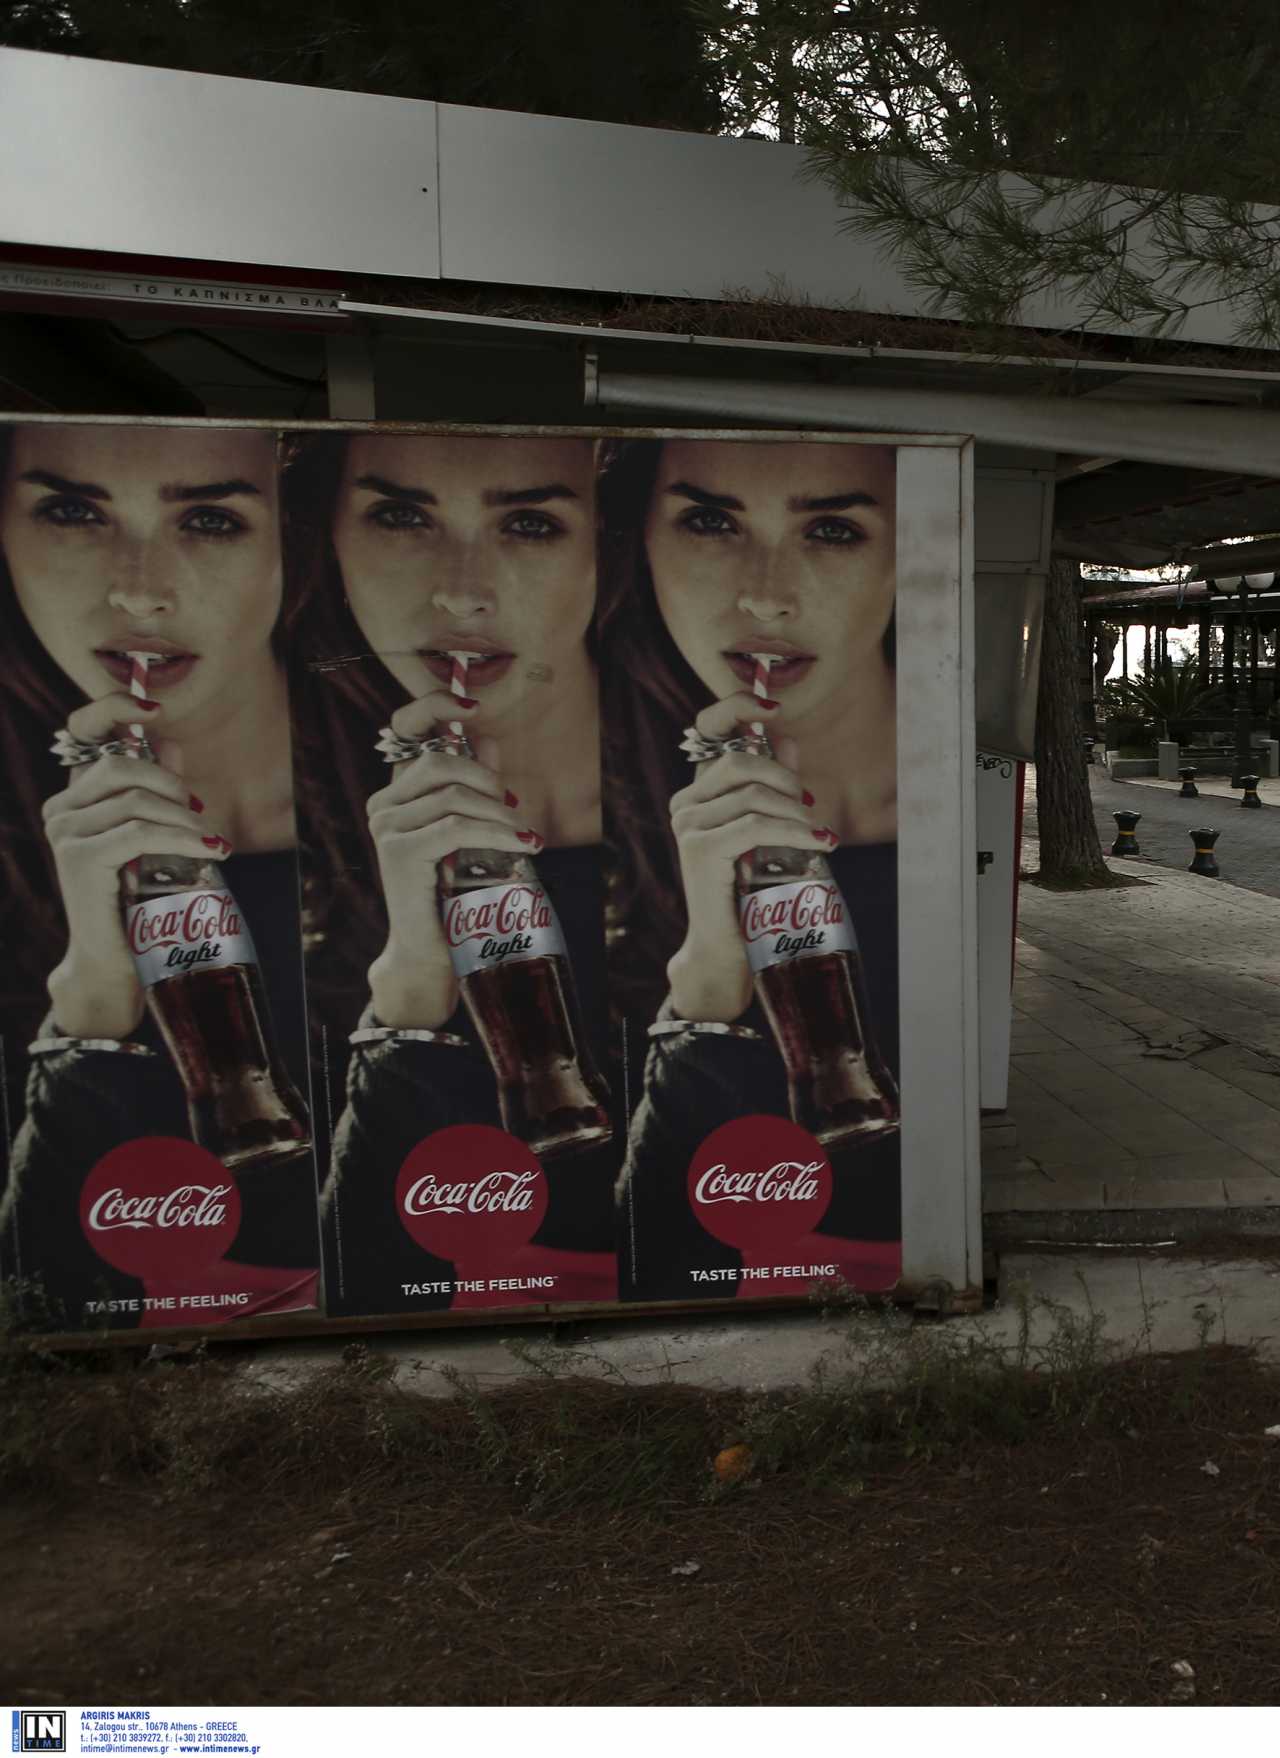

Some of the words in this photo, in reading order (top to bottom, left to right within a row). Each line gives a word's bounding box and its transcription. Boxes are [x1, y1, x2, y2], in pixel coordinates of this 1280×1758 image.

[133, 283, 158, 295] ΤΟ
[173, 287, 285, 306] ΚΑΠΝΙΣΜΑ
[128, 894, 240, 955] Coca-Cola
[447, 886, 551, 948] Coca-Cola
[742, 884, 843, 943] Coca-Cola
[165, 941, 222, 969] light
[478, 932, 533, 961] light
[774, 928, 825, 956] light
[404, 1171, 541, 1216] Coca-Cola
[695, 1161, 827, 1204] Coca-Cola
[88, 1185, 233, 1231] Coca-Cola
[401, 1281, 451, 1296] TASTE
[454, 1279, 486, 1292] THE
[690, 1268, 738, 1282] TASTE
[740, 1266, 770, 1280] THE
[86, 1299, 140, 1313] TASTE
[143, 1297, 177, 1310] THE
